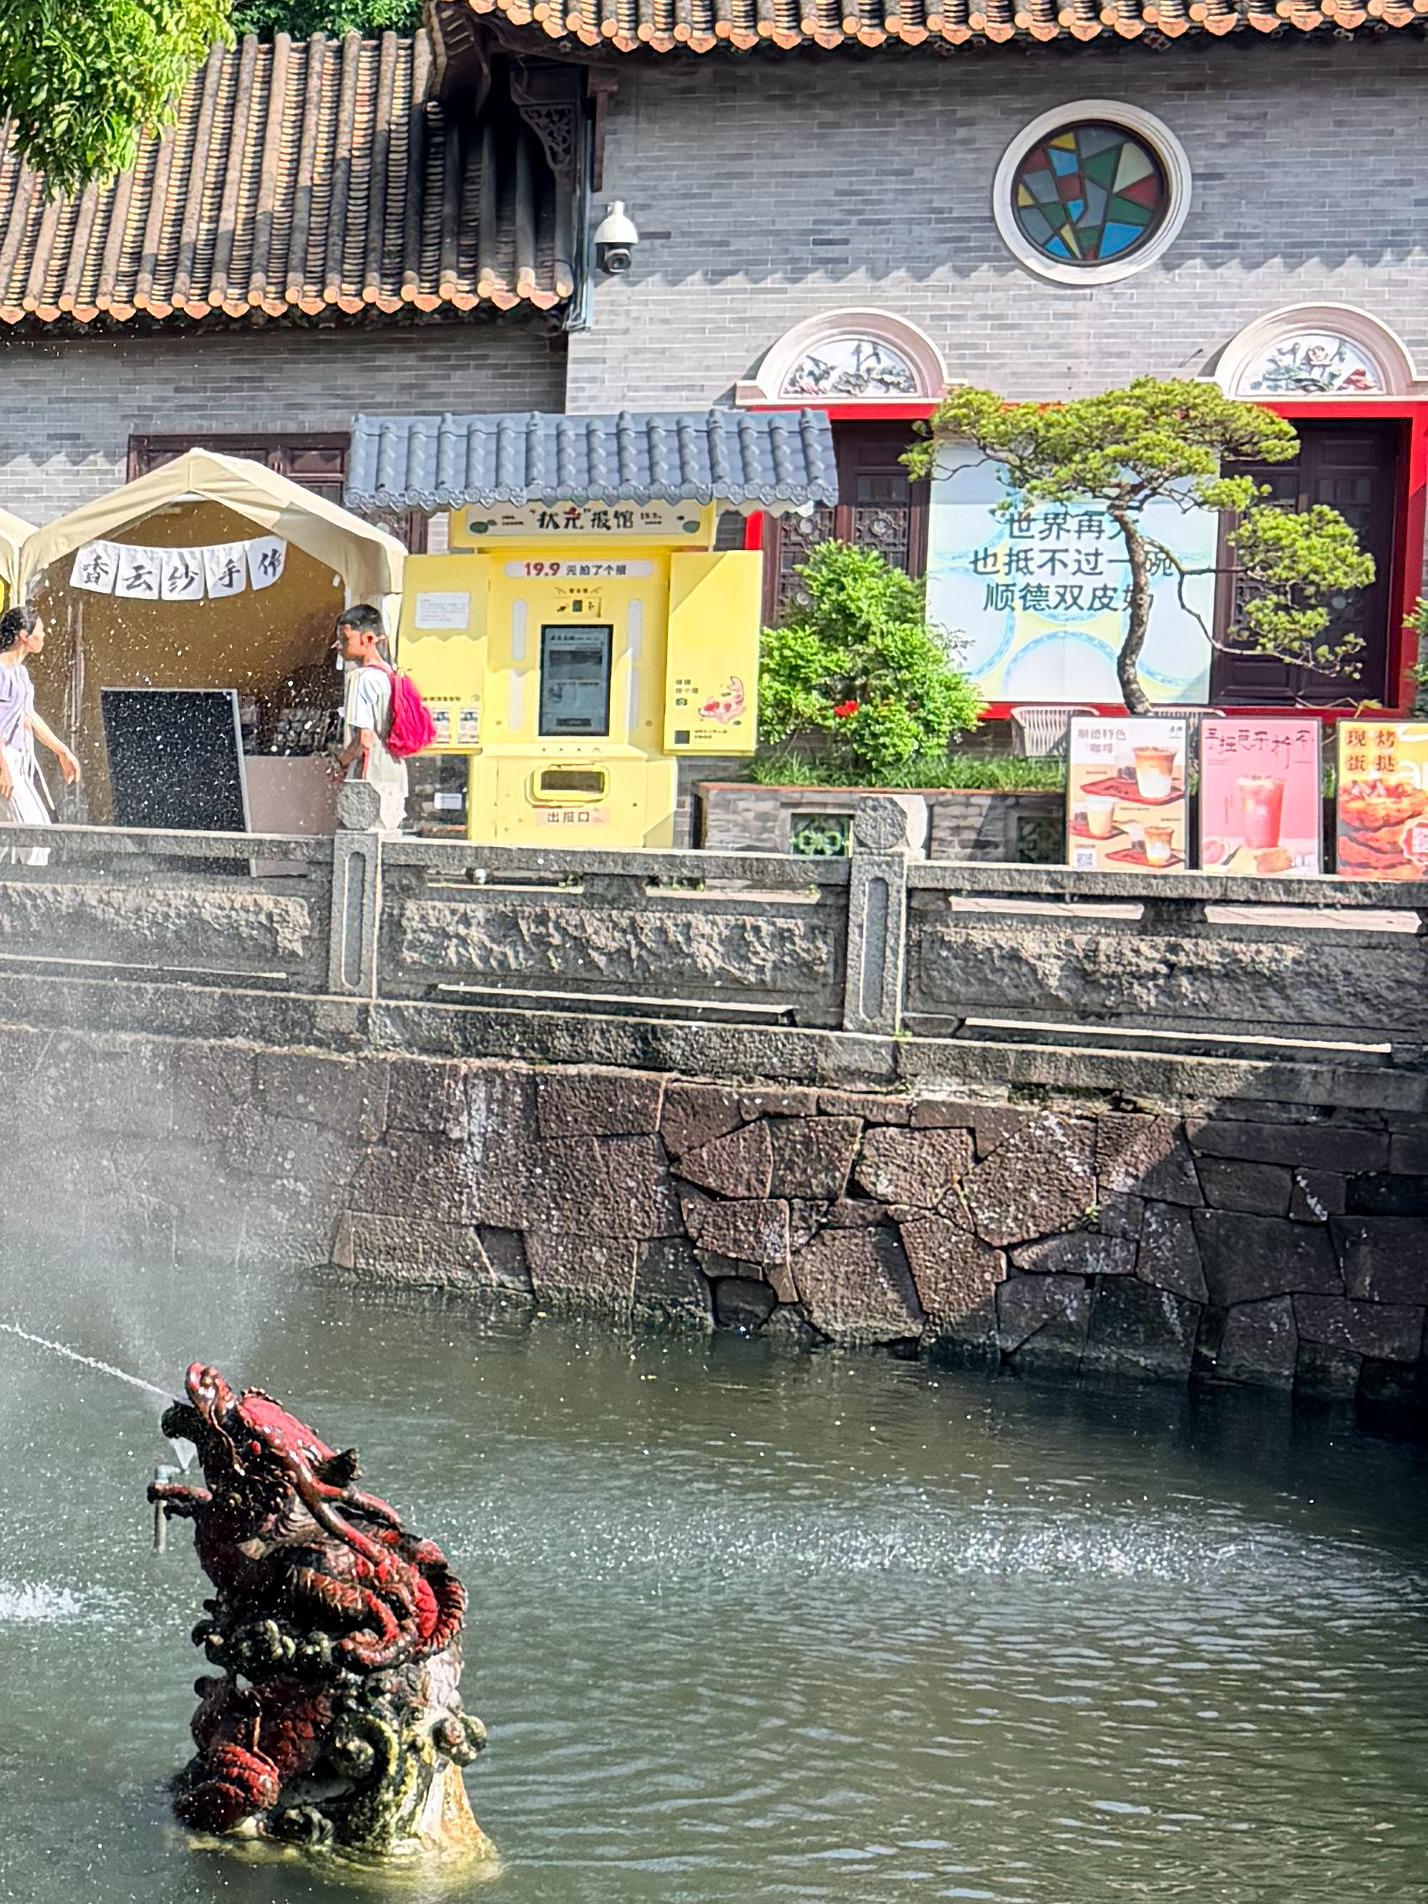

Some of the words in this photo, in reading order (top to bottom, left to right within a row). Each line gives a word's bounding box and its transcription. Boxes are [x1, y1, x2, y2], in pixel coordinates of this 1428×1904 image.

[82, 548, 282, 594] 香云纱手作
[969, 547, 1174, 577] 也抵不过一碗
